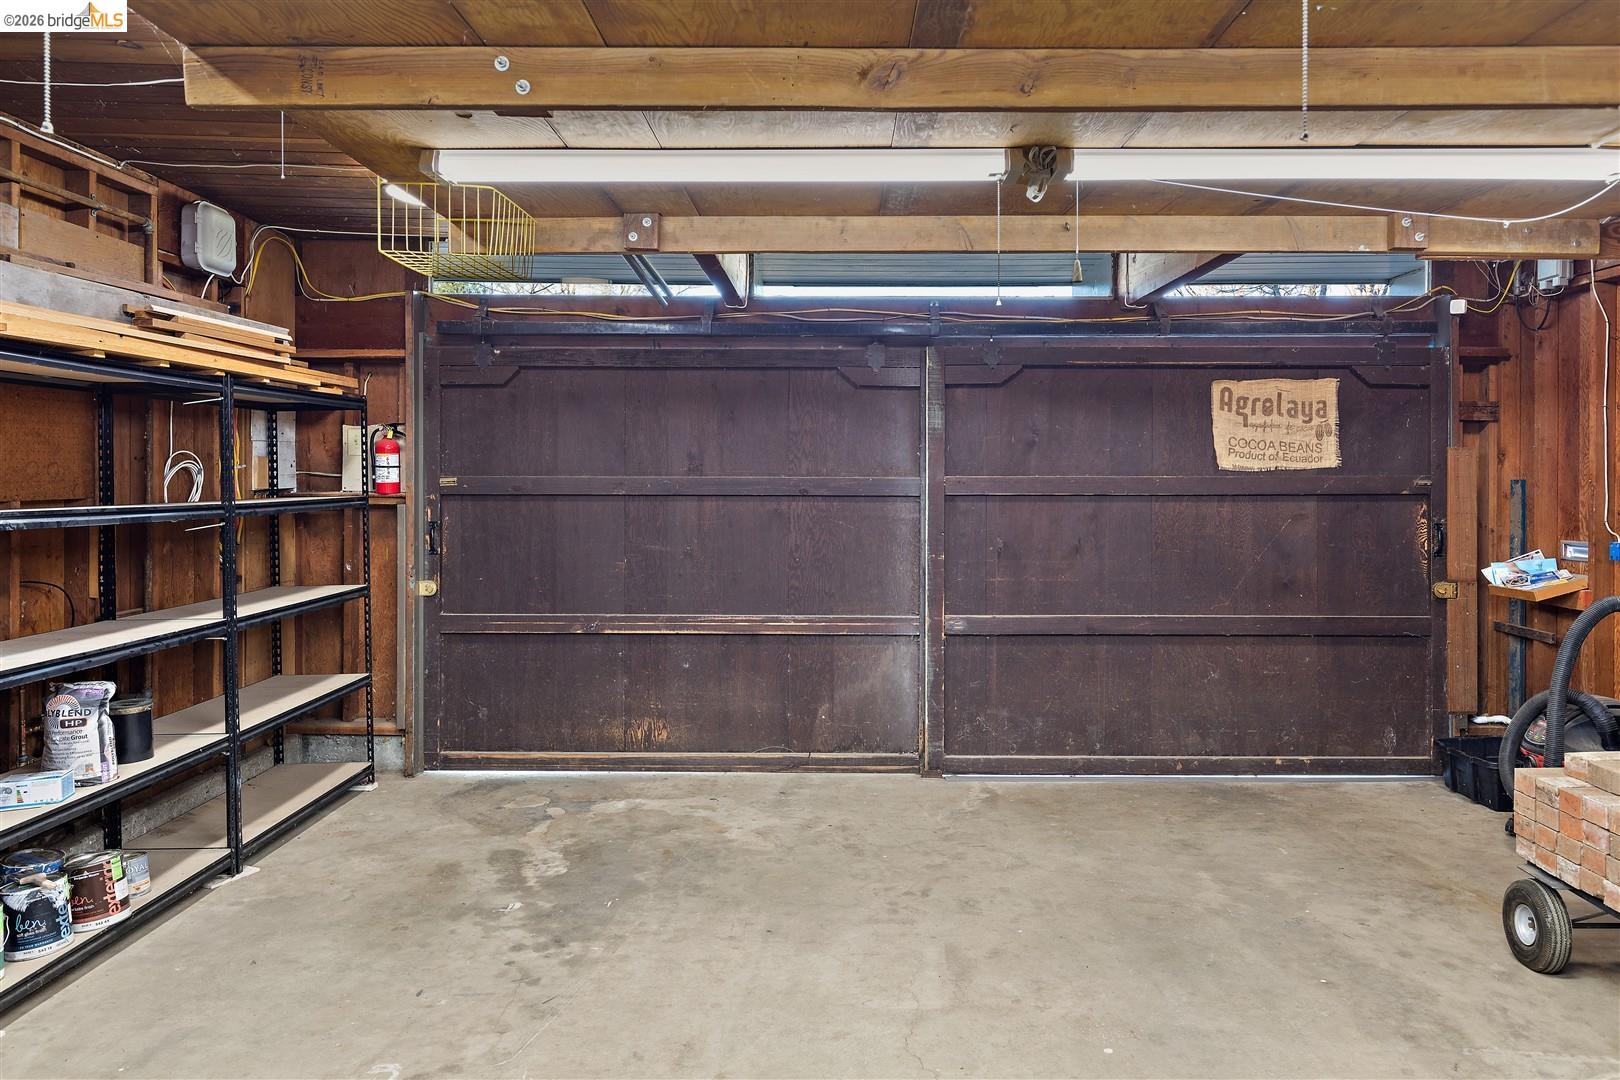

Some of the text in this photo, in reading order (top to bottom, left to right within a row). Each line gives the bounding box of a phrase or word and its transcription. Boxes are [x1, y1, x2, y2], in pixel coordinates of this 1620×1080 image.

[1228, 436, 1323, 454] COCOA BEANS
[1228, 447, 1324, 464] Product of Ecuador
[47, 708, 91, 718] LYBLEND
[64, 719, 83, 728] HP
[71, 733, 88, 741] Grout
[125, 863, 149, 875] OYAL
